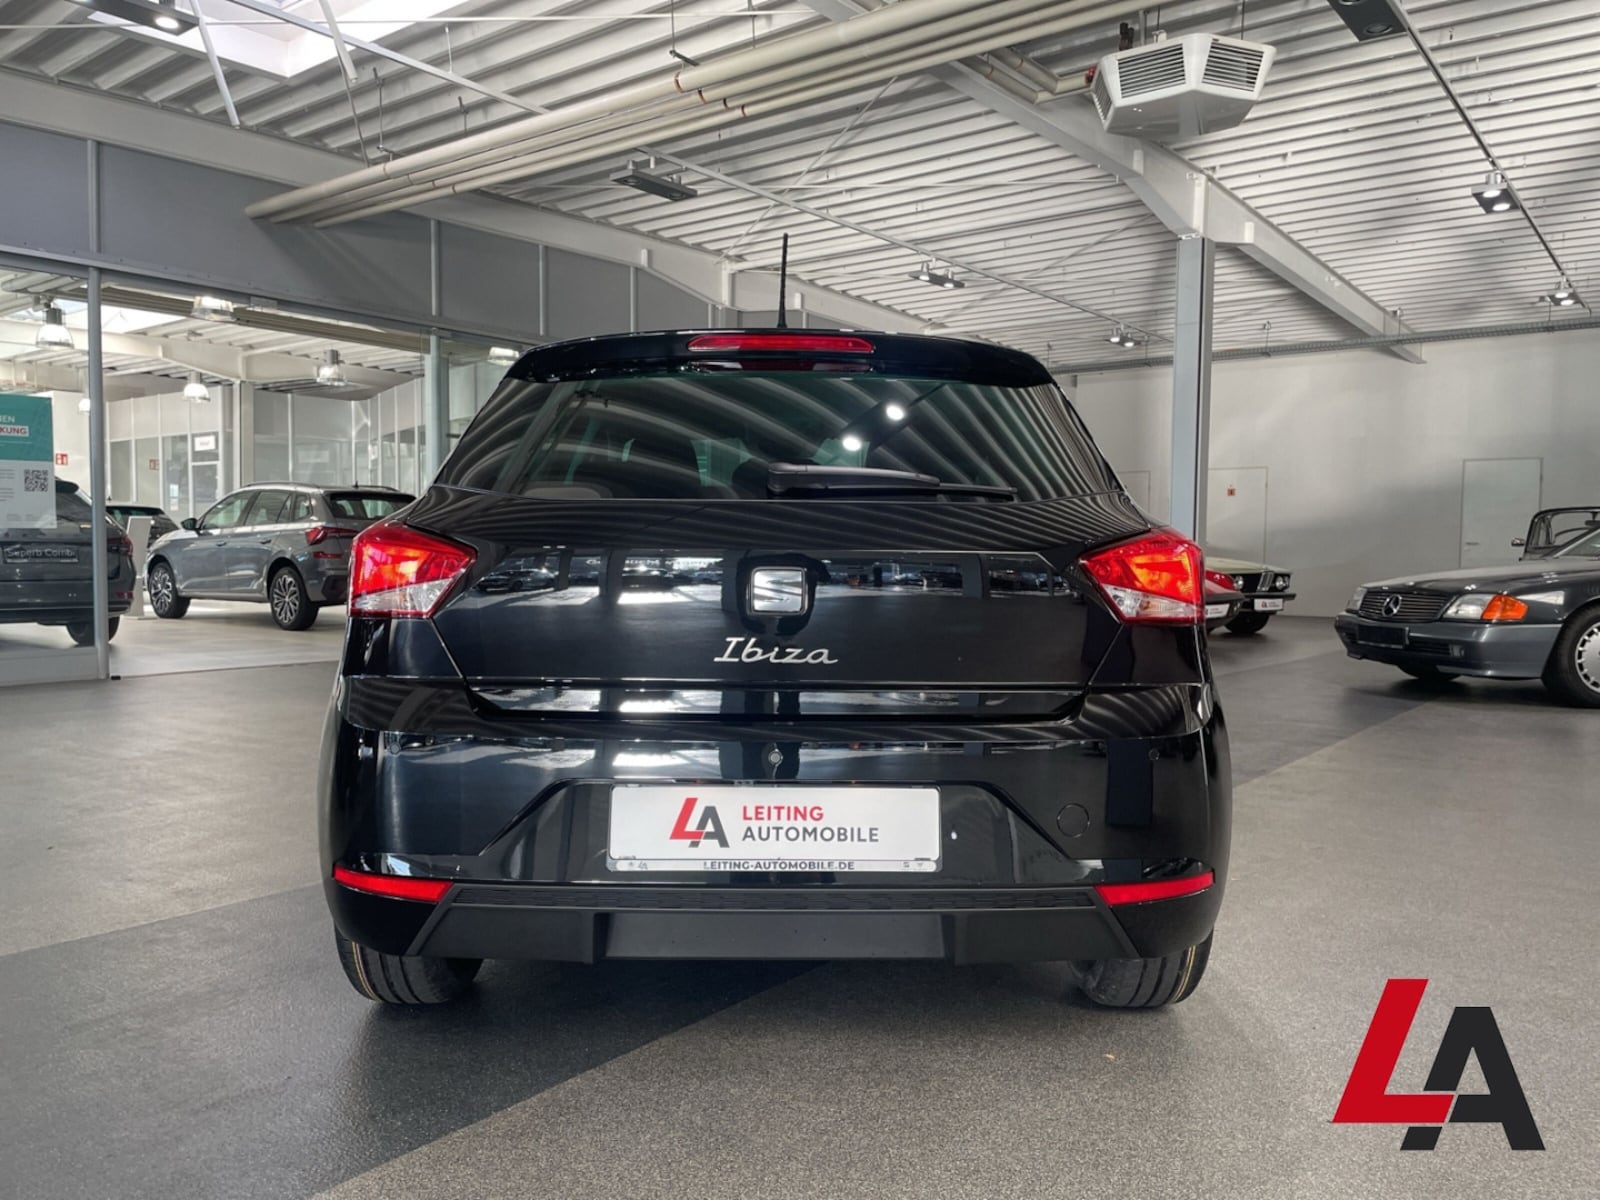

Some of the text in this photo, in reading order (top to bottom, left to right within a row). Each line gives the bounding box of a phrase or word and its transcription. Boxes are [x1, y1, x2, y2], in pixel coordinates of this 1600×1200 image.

[713, 637, 839, 664] Ibiza
[742, 805, 824, 821] LEITING
[742, 826, 879, 843] AUTOMOBILE
[703, 860, 855, 871] LEITING-AUTOMOBILE.DE
